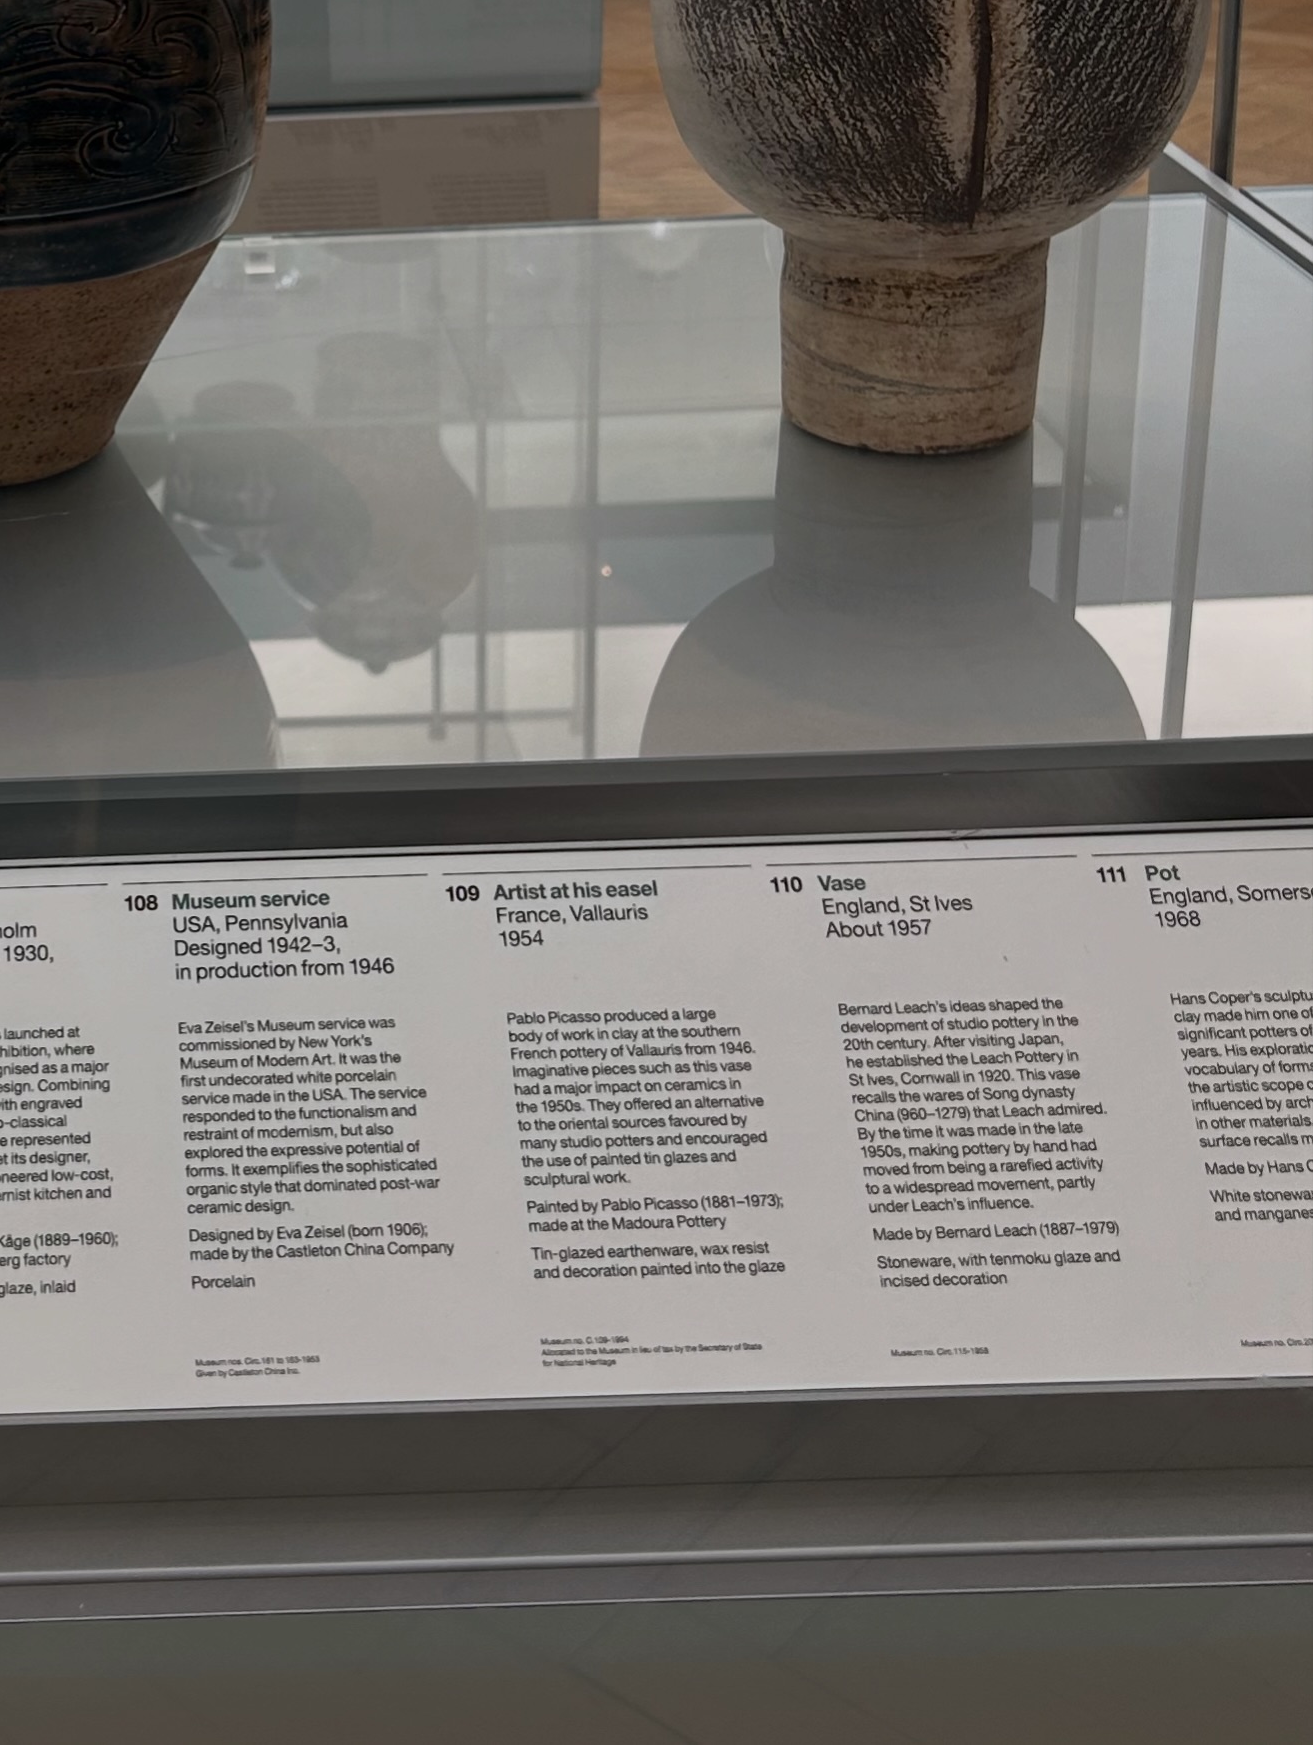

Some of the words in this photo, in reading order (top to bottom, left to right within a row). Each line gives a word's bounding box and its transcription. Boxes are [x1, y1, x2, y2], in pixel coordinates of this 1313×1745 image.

[1096, 866, 1126, 883] 111
[1144, 865, 1181, 882] Pot
[445, 885, 480, 902] 109
[493, 883, 547, 901] Artist
[550, 883, 570, 900] at
[572, 881, 603, 898] his
[605, 880, 658, 898] easel
[770, 876, 803, 893] 110
[817, 875, 866, 892] Vase
[124, 894, 159, 912] 108
[172, 893, 256, 910] Museum
[260, 890, 330, 907] service
[1149, 886, 1233, 907] England,
[1236, 884, 1313, 902] Somers
[496, 907, 566, 924] France,
[569, 903, 649, 922] Vallauris
[822, 896, 906, 917] England,
[909, 895, 931, 913] St
[934, 895, 973, 911] Ives
[173, 916, 220, 934] USA,
[225, 912, 348, 934] Pennsylvania
[826, 921, 884, 938] About
[887, 918, 931, 936] 1957
[1155, 910, 1201, 928] 1968
[499, 929, 544, 947] 1954
[3, 944, 54, 963] 1930,
[174, 937, 262, 960] Designed
[175, 963, 191, 980] in
[196, 960, 297, 984] production
[301, 959, 345, 976] from
[349, 957, 395, 975] 1946
[1177, 1026, 1247, 1043] significant
[1249, 1026, 1299, 1042] potters
[180, 1075, 207, 1087] first
[208, 1072, 294, 1087] undecorated
[296, 1071, 333, 1084] white
[335, 1069, 397, 1086] porcelain
[20, 1096, 83, 1113] engraved
[183, 1127, 239, 1141] restraint
[241, 1126, 255, 1140] of
[257, 1125, 338, 1139] modernism,
[340, 1124, 363, 1137] but
[365, 1123, 394, 1136] also
[520, 1139, 557, 1152] many
[559, 1135, 603, 1149] studio
[605, 1134, 654, 1150] potters
[656, 1132, 683, 1146] and
[685, 1130, 768, 1147] encouraged
[863, 1162, 911, 1176] moved
[912, 1161, 945, 1175] from
[947, 1160, 987, 1176] being
[989, 1162, 999, 1173] a
[1000, 1157, 1053, 1172] rarefied
[1055, 1156, 1103, 1172] activity
[528, 1218, 569, 1232] made
[570, 1218, 585, 1232] at
[586, 1218, 609, 1231] the
[611, 1216, 675, 1230] Madoura
[676, 1215, 726, 1230] Pottery
[23, 1253, 71, 1268] factory
[191, 1275, 256, 1289] Porcelain
